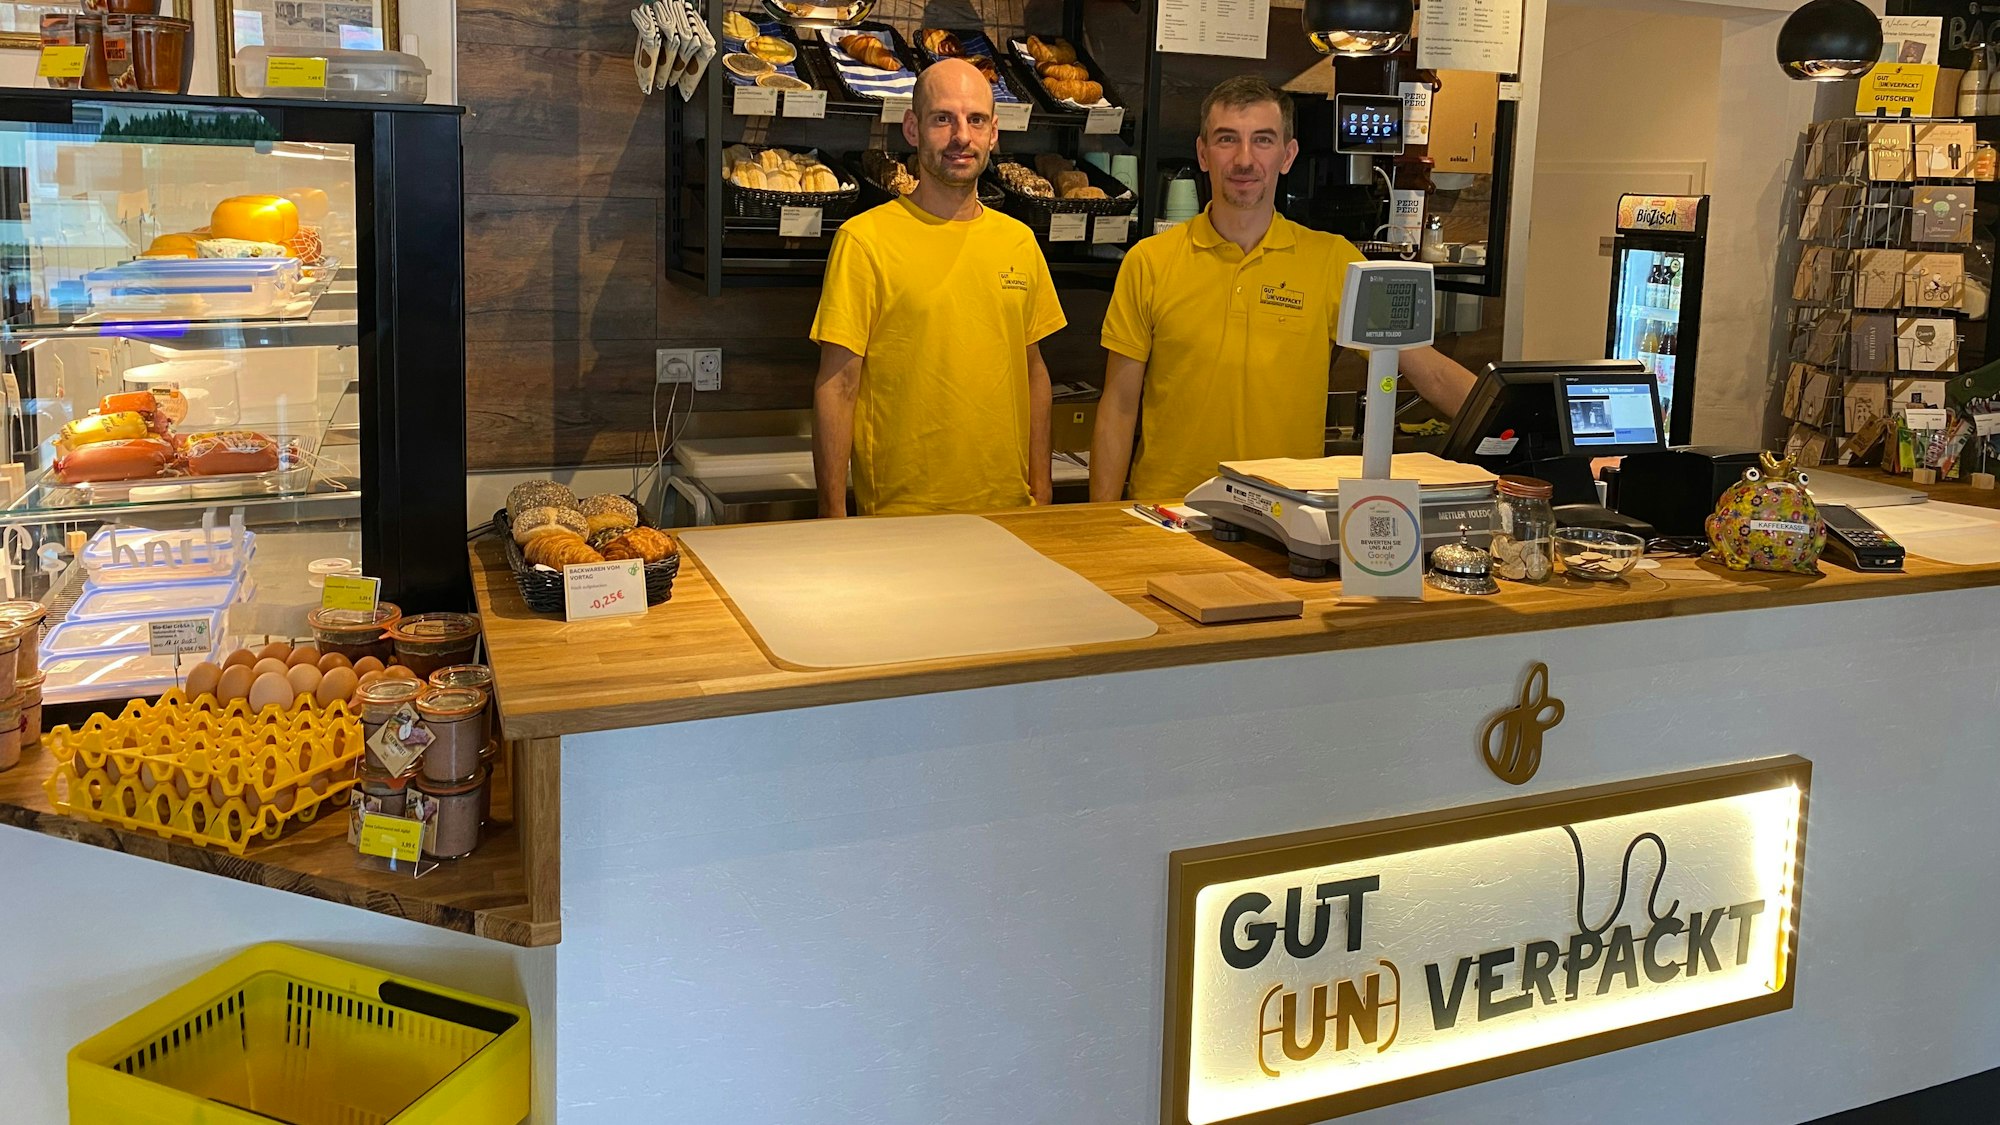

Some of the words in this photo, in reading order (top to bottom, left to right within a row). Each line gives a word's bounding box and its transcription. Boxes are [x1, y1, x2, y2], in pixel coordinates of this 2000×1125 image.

[106, 49, 126, 59] WURST
[1438, 510, 1466, 520] METTLER
[1758, 522, 1805, 531] KAFFEEKASSE
[1368, 551, 1395, 561] Google
[590, 590, 625, 609] -0,25€
[386, 732, 407, 756] LEBERWURST
[1219, 874, 1380, 970] GUT
[1424, 899, 1766, 1031] VERPACKT
